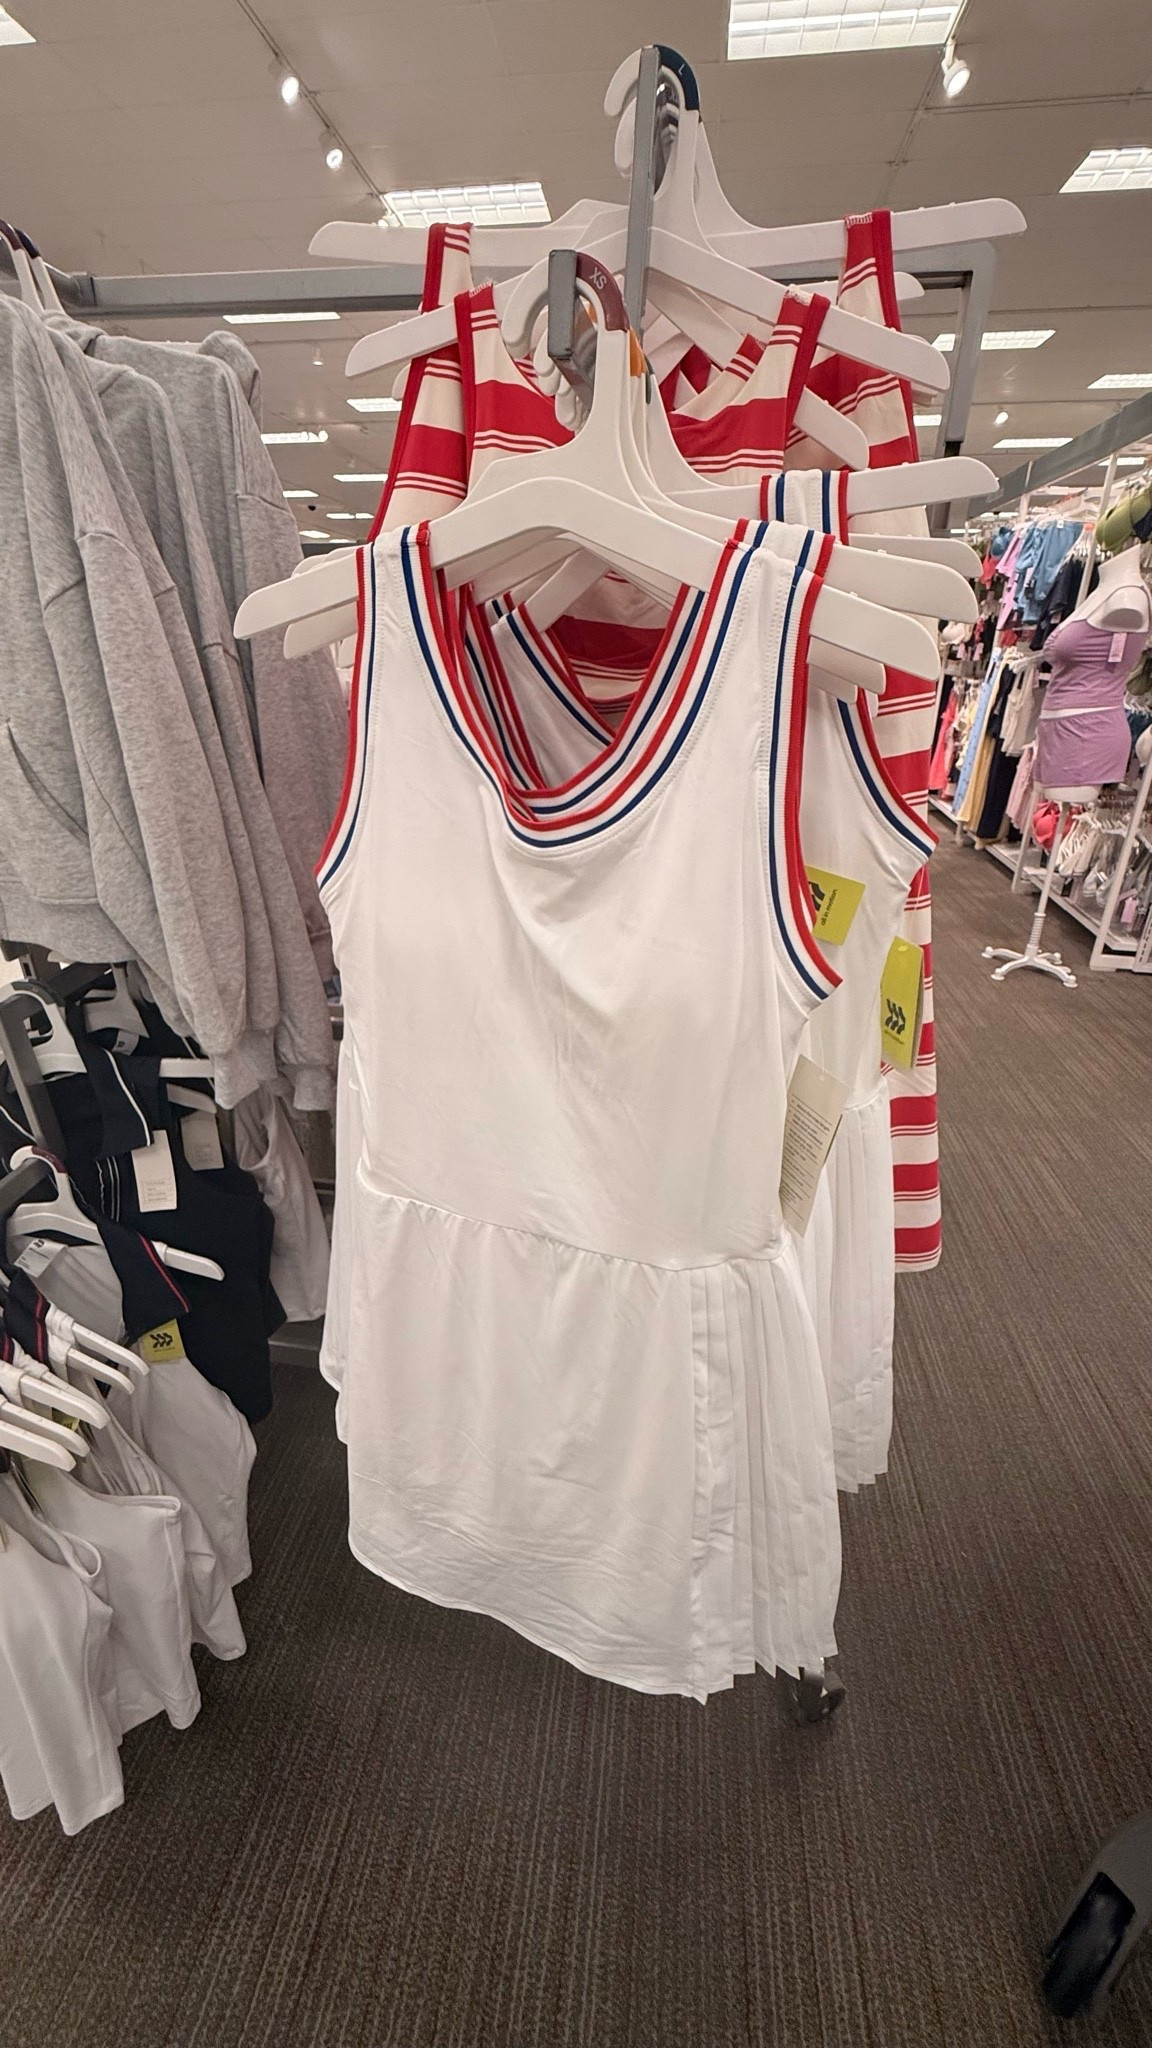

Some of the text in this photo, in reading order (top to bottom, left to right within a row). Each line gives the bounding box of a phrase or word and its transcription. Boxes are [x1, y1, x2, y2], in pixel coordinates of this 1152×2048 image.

[678, 63, 685, 76] L
[589, 266, 607, 290] XS
[826, 889, 838, 912] motion
